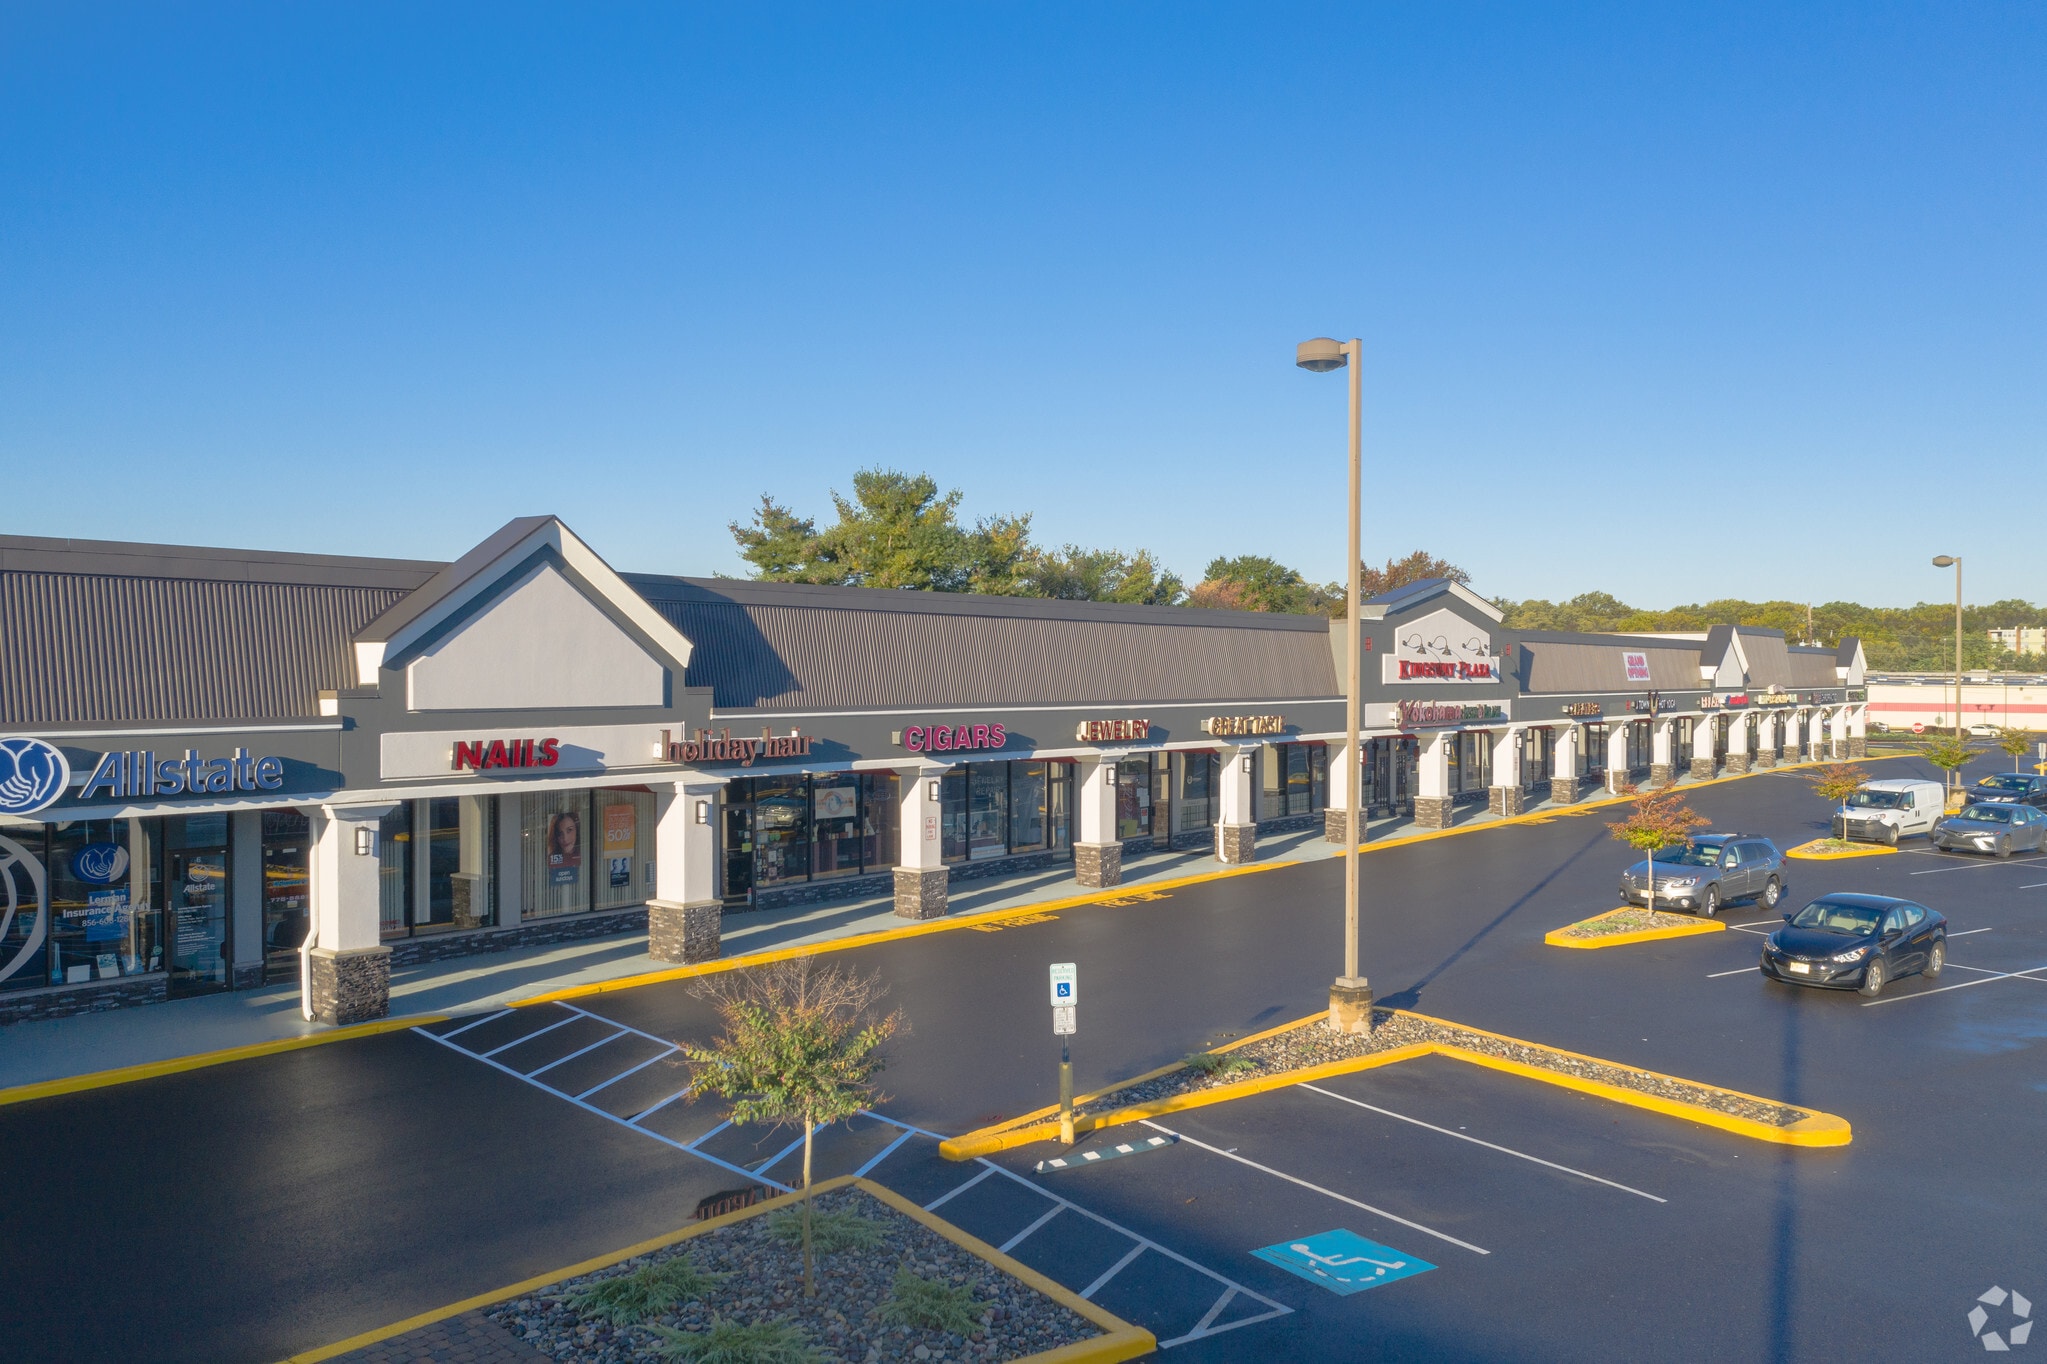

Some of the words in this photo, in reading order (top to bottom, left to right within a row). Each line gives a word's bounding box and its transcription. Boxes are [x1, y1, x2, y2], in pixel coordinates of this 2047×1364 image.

[1458, 660, 1491, 680] PLAZA
[1209, 716, 1249, 736] GREAT
[1250, 715, 1286, 734] TASTE
[1397, 699, 1461, 727] Yokohama
[902, 723, 1006, 752] CIGARS
[1078, 719, 1151, 741] JEWELRY
[452, 737, 560, 770] NAILS
[662, 727, 760, 767] holiday
[762, 725, 815, 758] hair
[78, 747, 283, 799] Allstate
[183, 884, 216, 893] Allstate
[63, 906, 112, 919] Insurance
